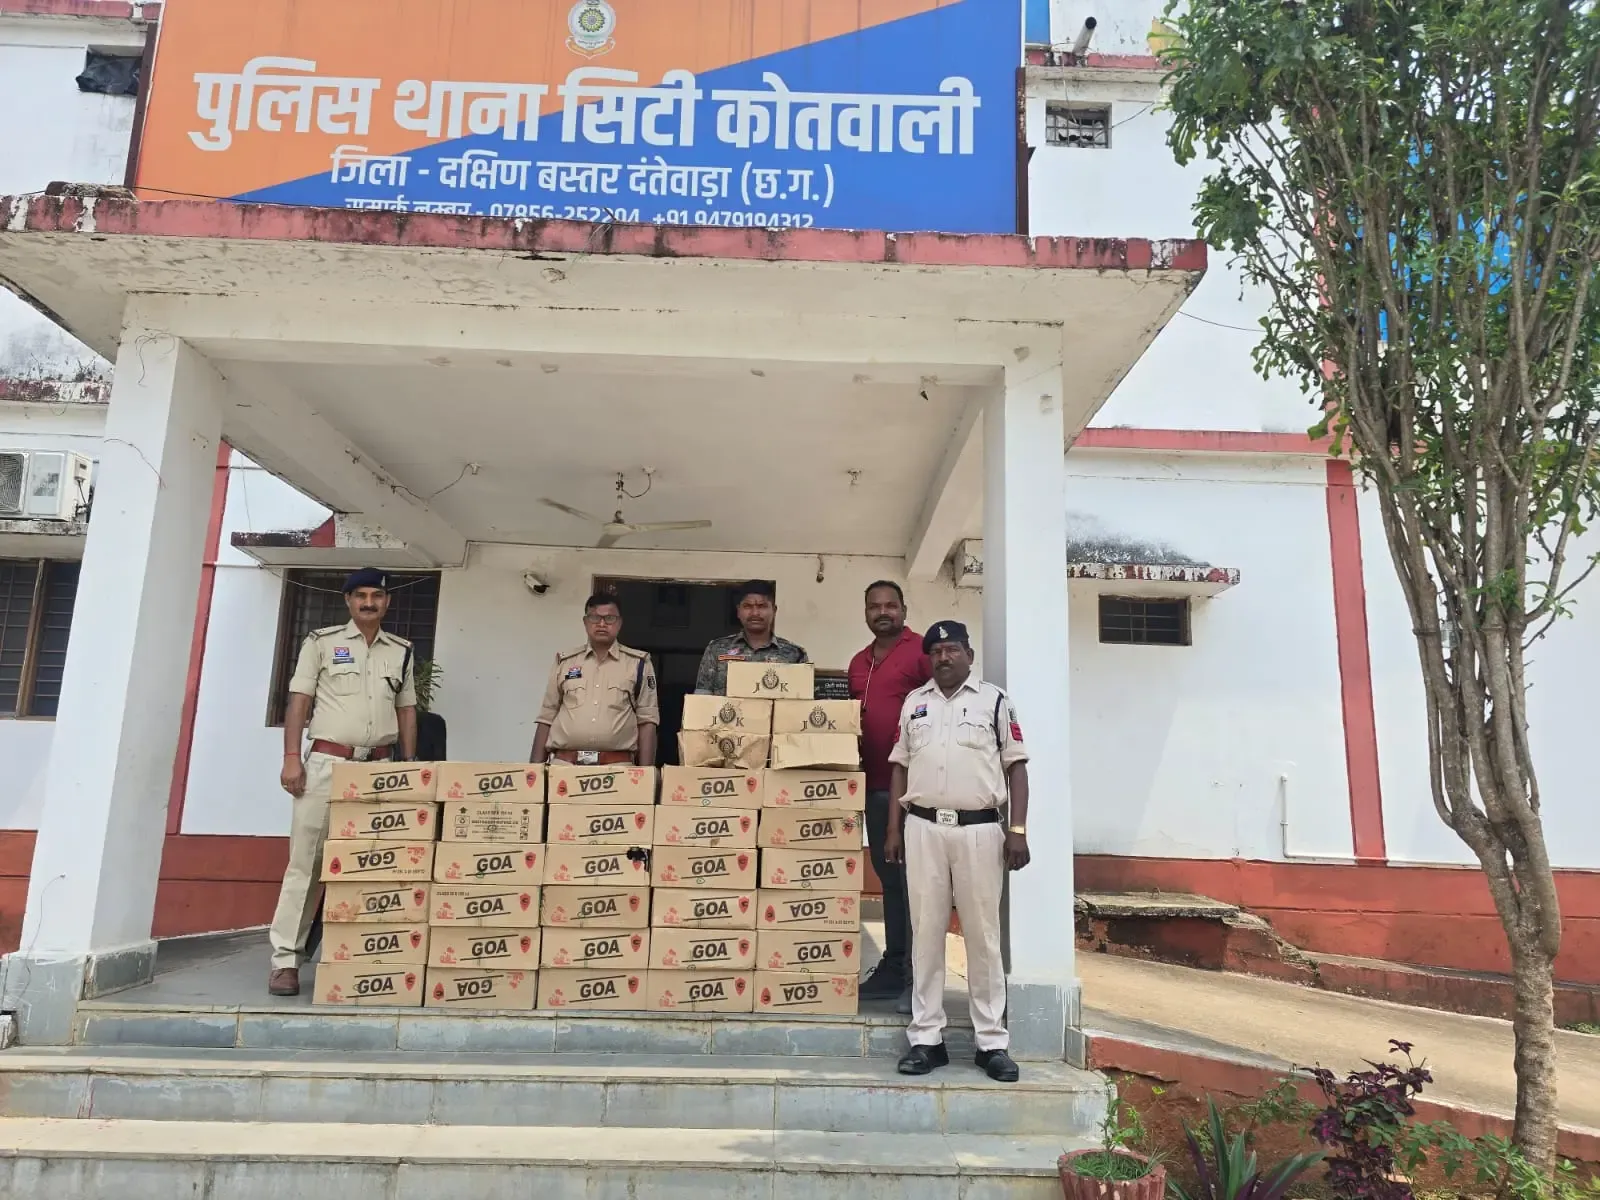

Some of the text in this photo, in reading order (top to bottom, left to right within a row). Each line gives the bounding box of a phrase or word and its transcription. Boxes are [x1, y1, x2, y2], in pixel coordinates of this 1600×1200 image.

[187, 56, 982, 155] पुलिस थाना सिटी कोतवाली
[330, 144, 411, 186] जिला
[438, 149, 531, 190] दक्षिण
[536, 161, 622, 194] बस्तर
[627, 156, 732, 205] दंतेवाड़ा
[741, 161, 834, 208] (छ.ग.)
[779, 683, 789, 692] K
[736, 717, 745, 727] K
[828, 720, 837, 730] K
[374, 774, 410, 790] GOA
[479, 774, 514, 792] GOA
[579, 776, 614, 792] GOA
[701, 780, 735, 796] GOA
[804, 783, 837, 798] GOA
[371, 813, 406, 830] GOA
[590, 817, 625, 834] GOA
[695, 820, 730, 836] GOA
[800, 822, 834, 838] GOA
[357, 852, 396, 868] GOA
[476, 855, 512, 873] GOA
[585, 858, 620, 874] GOA
[691, 858, 726, 876] GOA
[800, 862, 834, 878] GOA
[365, 894, 402, 912] GOA
[466, 898, 504, 915] GOA
[580, 898, 617, 916] GOA
[694, 900, 728, 917] GOA
[790, 902, 826, 918] GOA
[364, 935, 400, 952] GOA
[472, 940, 508, 956] GOA
[584, 940, 620, 957] GOA
[692, 942, 728, 958] GOA
[798, 944, 832, 960] GOA
[358, 977, 394, 994] GOA
[457, 980, 492, 996] GOA
[580, 980, 616, 998] GOA
[689, 982, 724, 1000] GOA
[784, 984, 818, 1001] GOA
